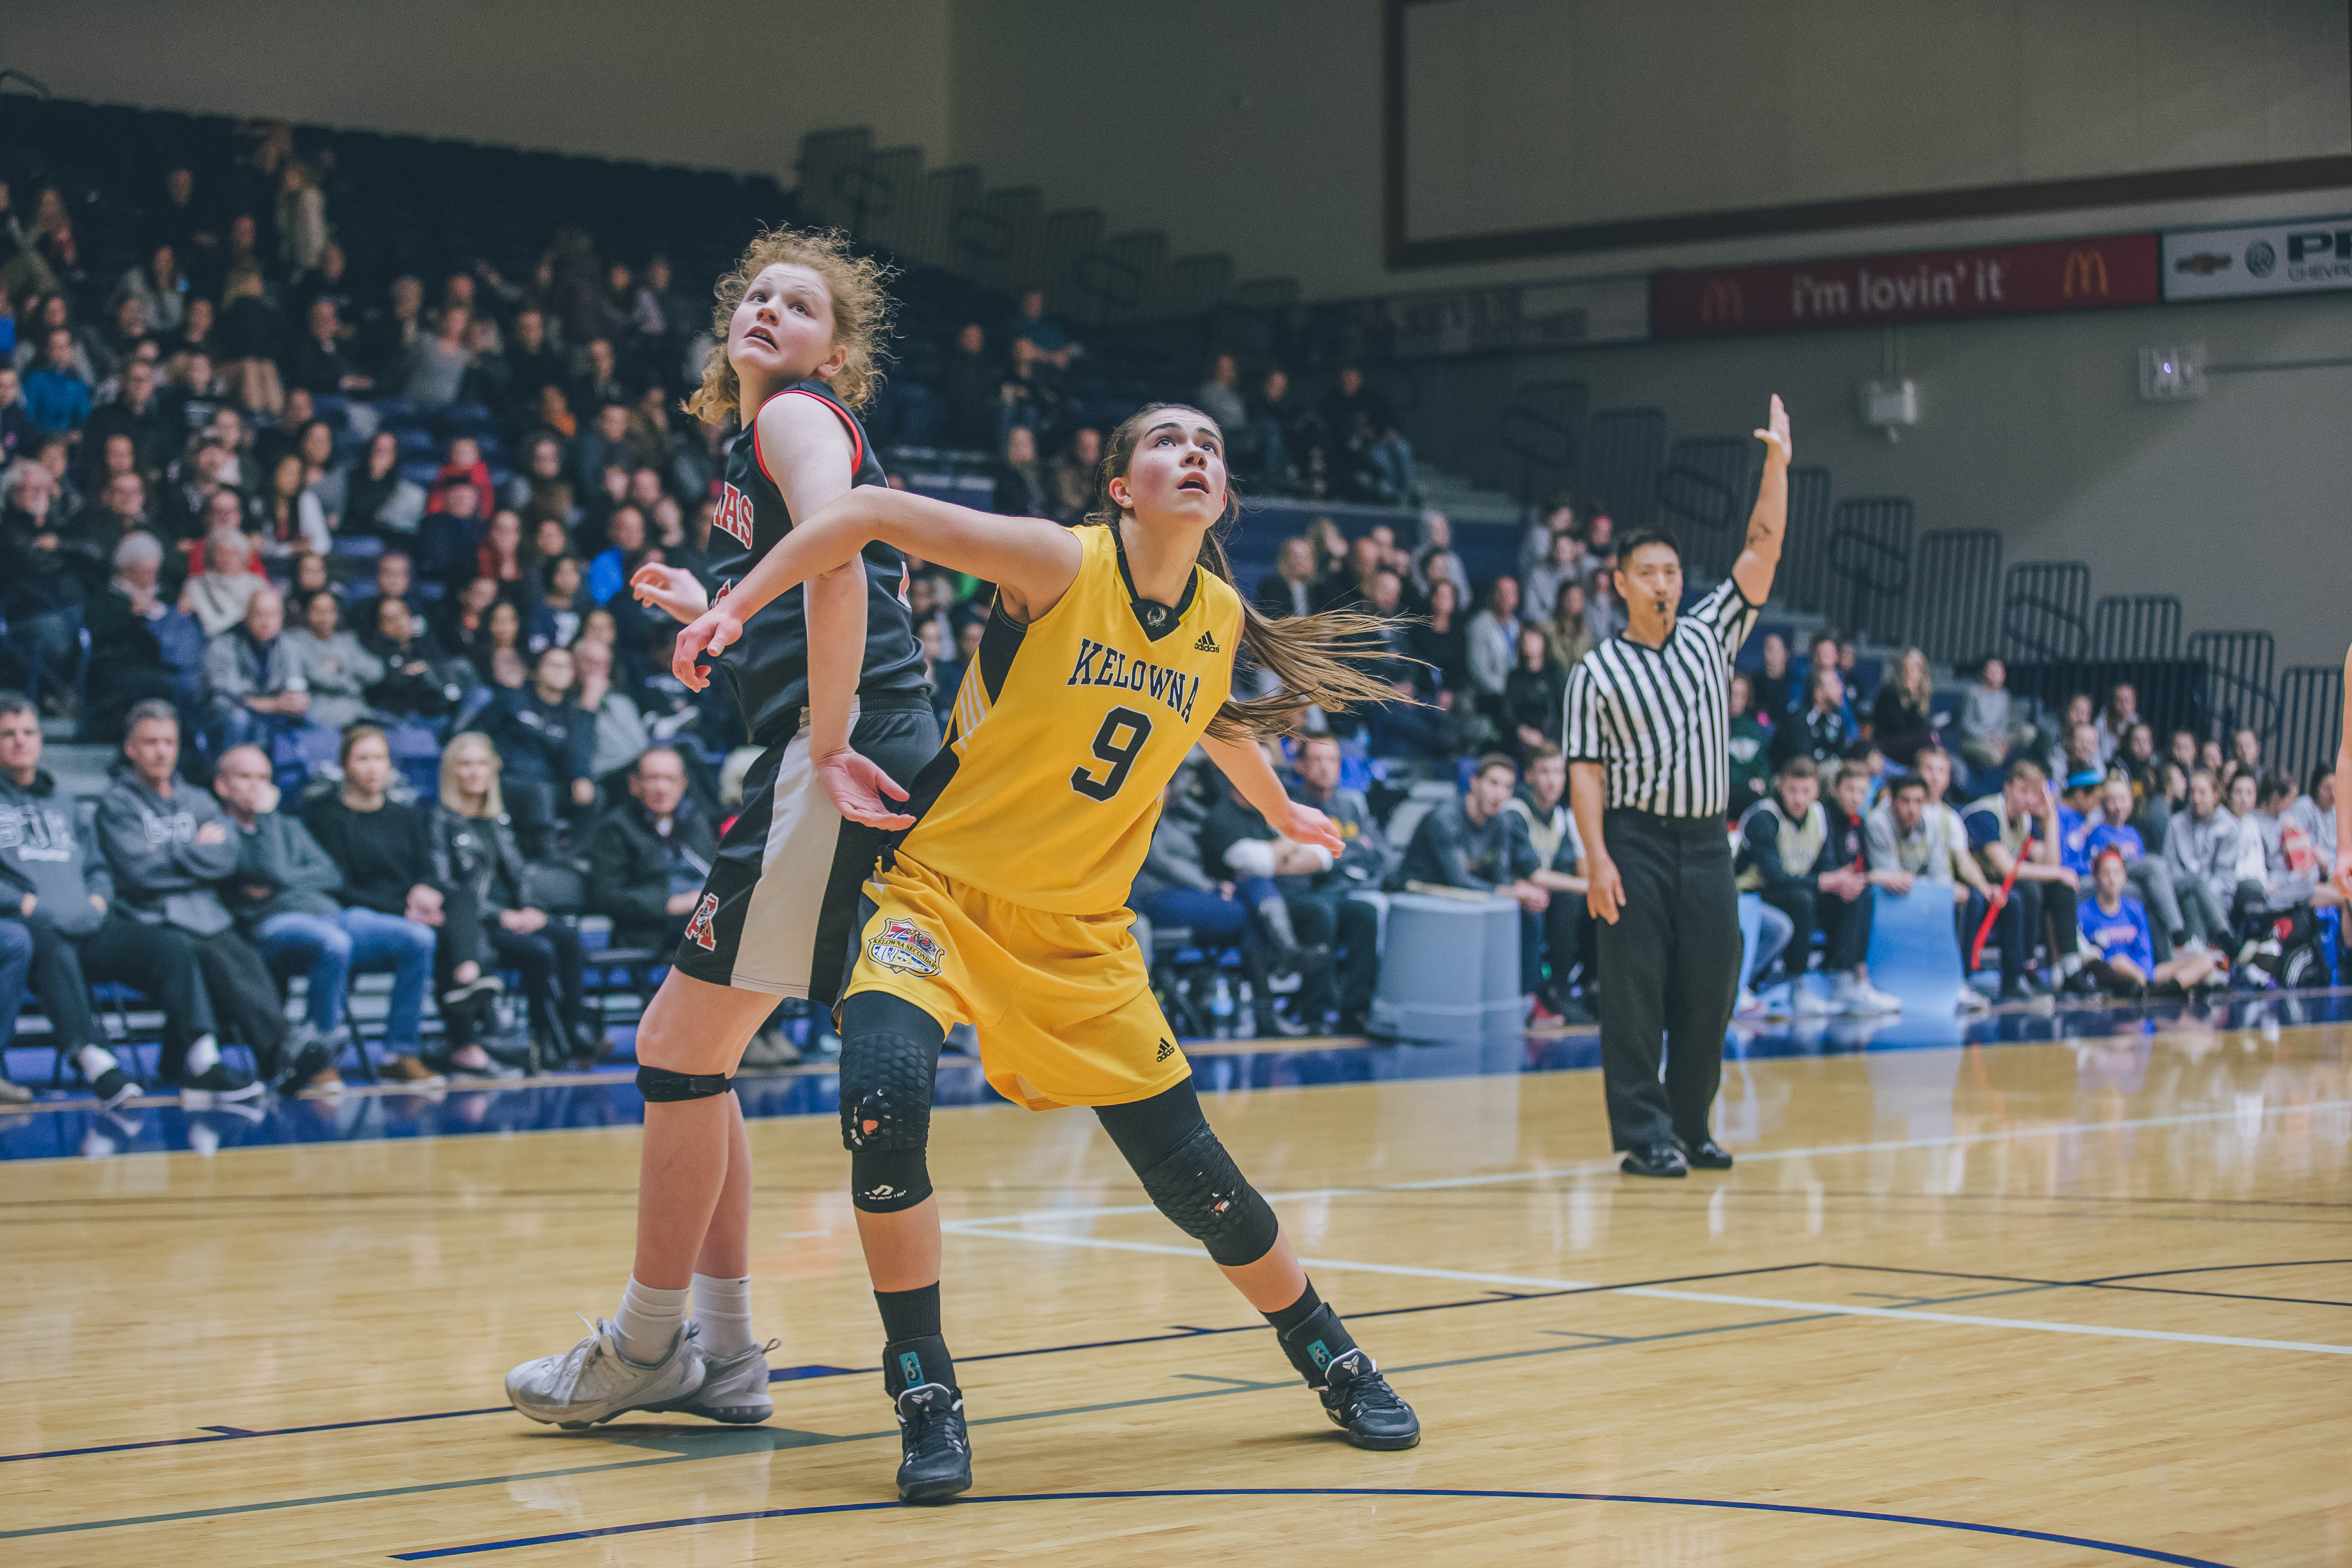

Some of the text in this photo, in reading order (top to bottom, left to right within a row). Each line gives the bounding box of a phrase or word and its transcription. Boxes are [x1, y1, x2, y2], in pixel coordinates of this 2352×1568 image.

[1792, 258, 2002, 318] i'm lovin' it
[1194, 643, 1220, 653] adidas
[1066, 637, 1200, 725] KELOWNA
[1069, 705, 1153, 803] 9
[873, 938, 938, 970] KELOWNA SECONDARY
[1157, 1046, 1175, 1062] adidas
